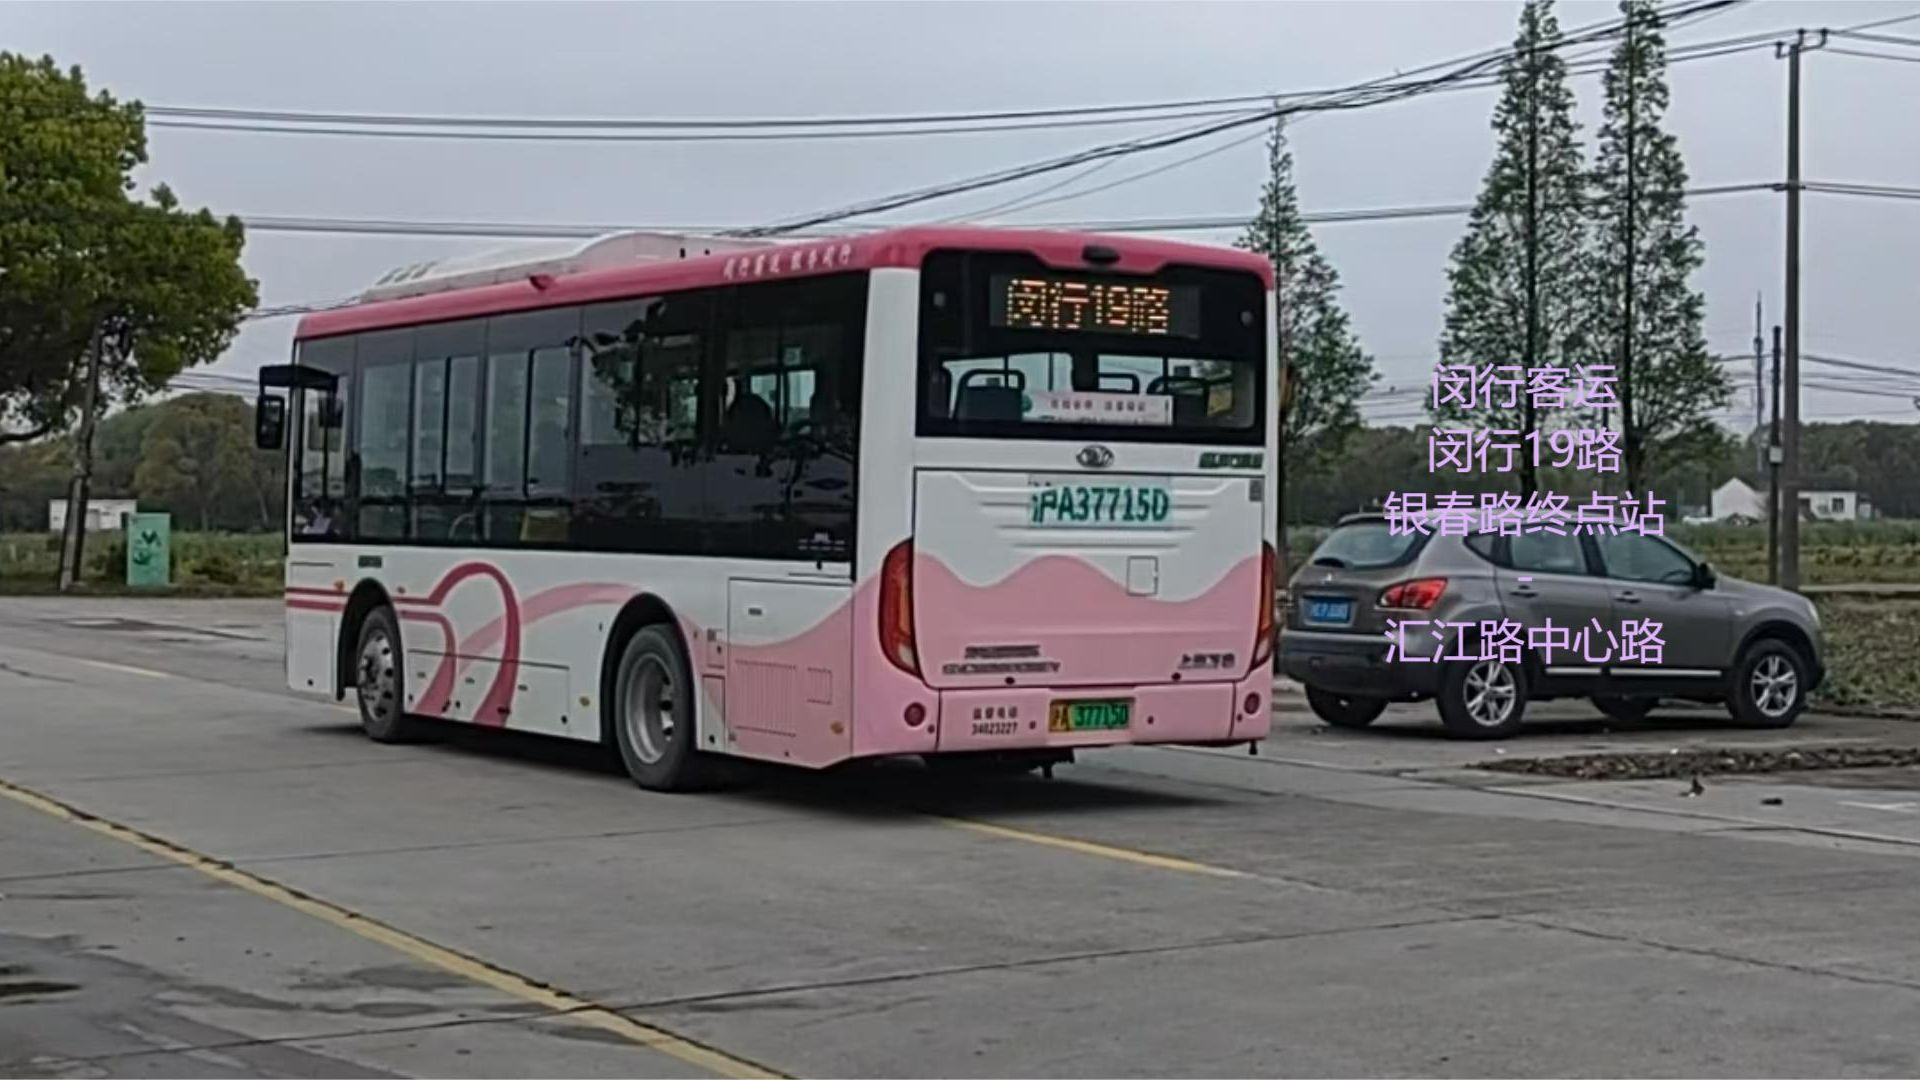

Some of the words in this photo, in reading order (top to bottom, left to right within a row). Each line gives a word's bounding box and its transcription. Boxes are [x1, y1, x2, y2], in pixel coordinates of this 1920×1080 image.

[1006, 279, 1170, 334] 闵行19路
[1030, 485, 1170, 525] 沪A37715D
